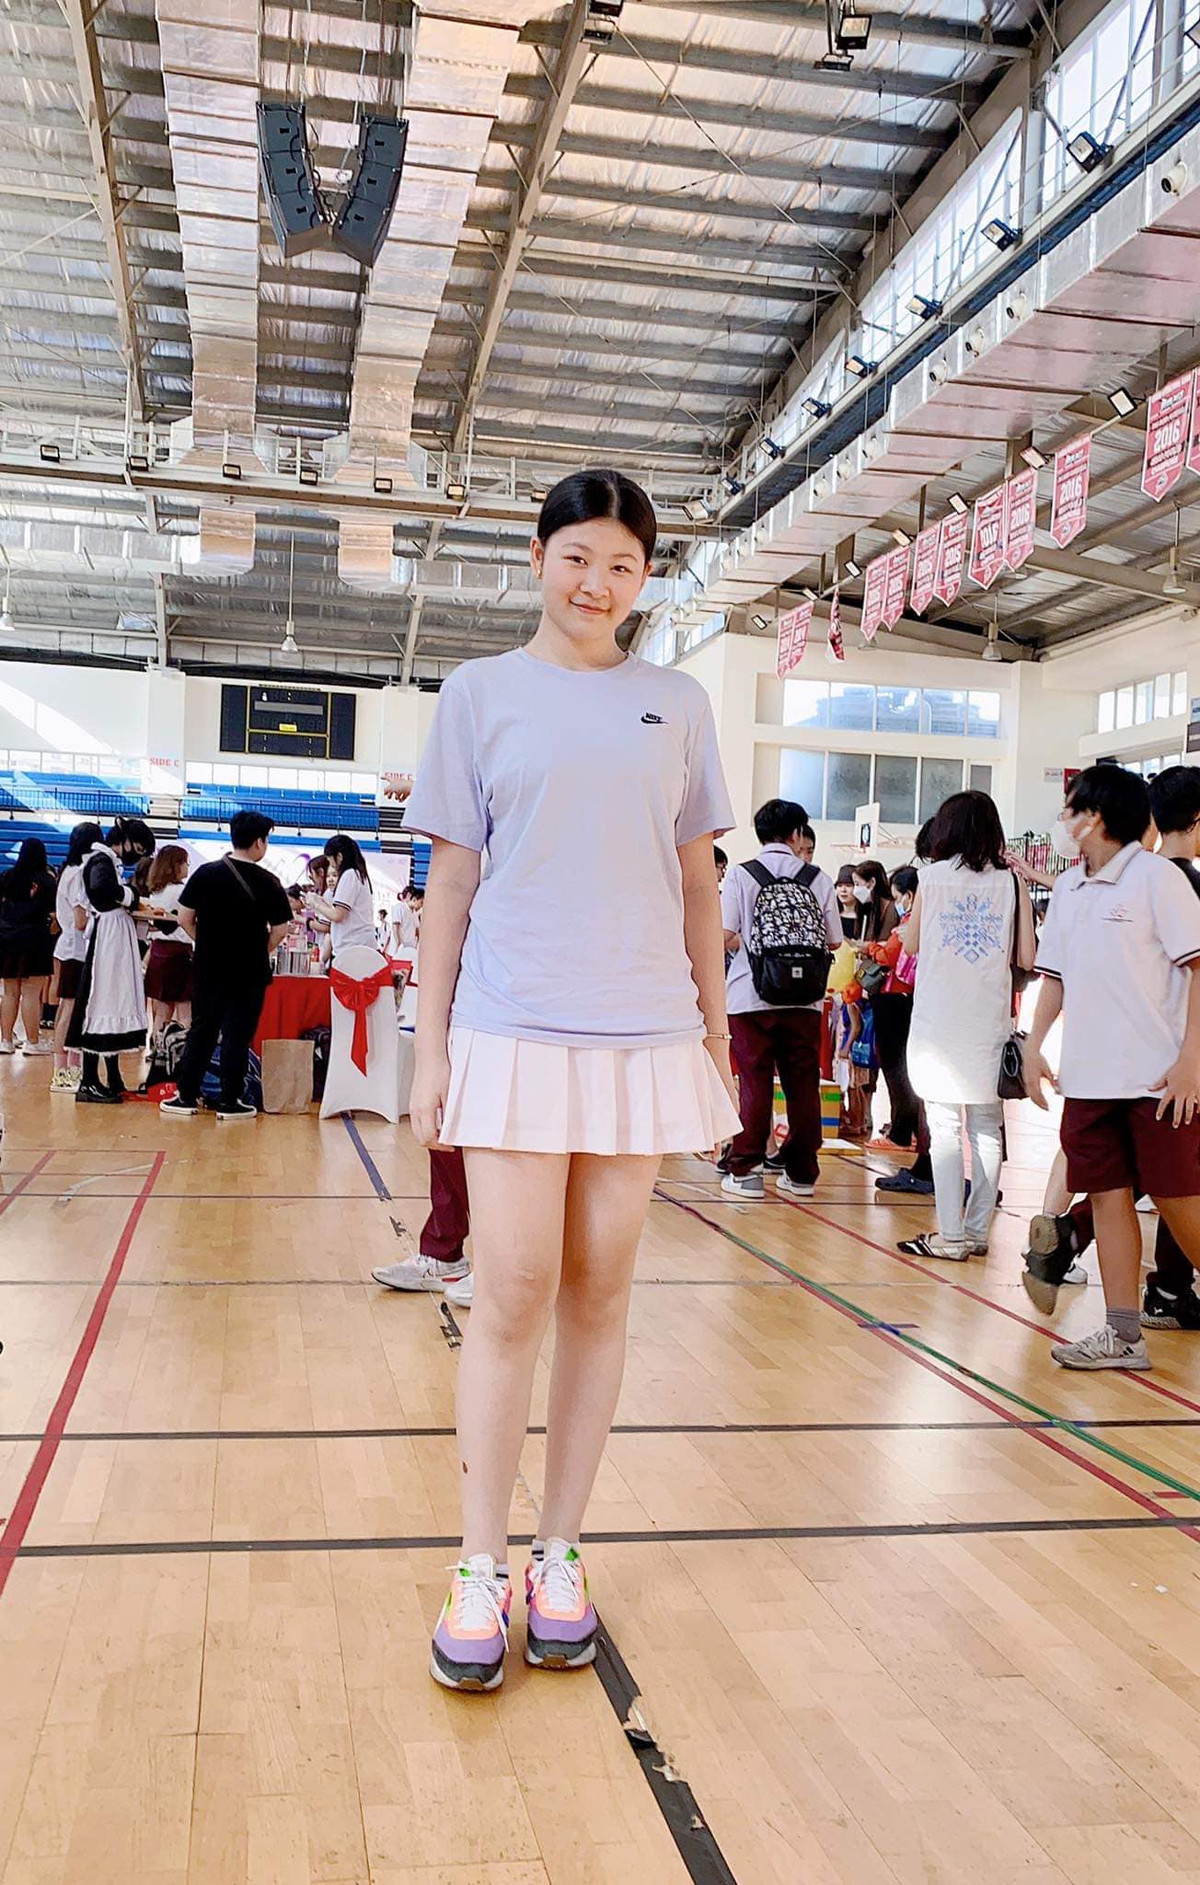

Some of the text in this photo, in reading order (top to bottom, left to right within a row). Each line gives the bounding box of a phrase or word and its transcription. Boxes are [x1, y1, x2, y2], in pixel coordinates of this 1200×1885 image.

[1153, 418, 1181, 454] 2016
[1060, 475, 1083, 506] 2016
[149, 757, 180, 768] SIDE C
